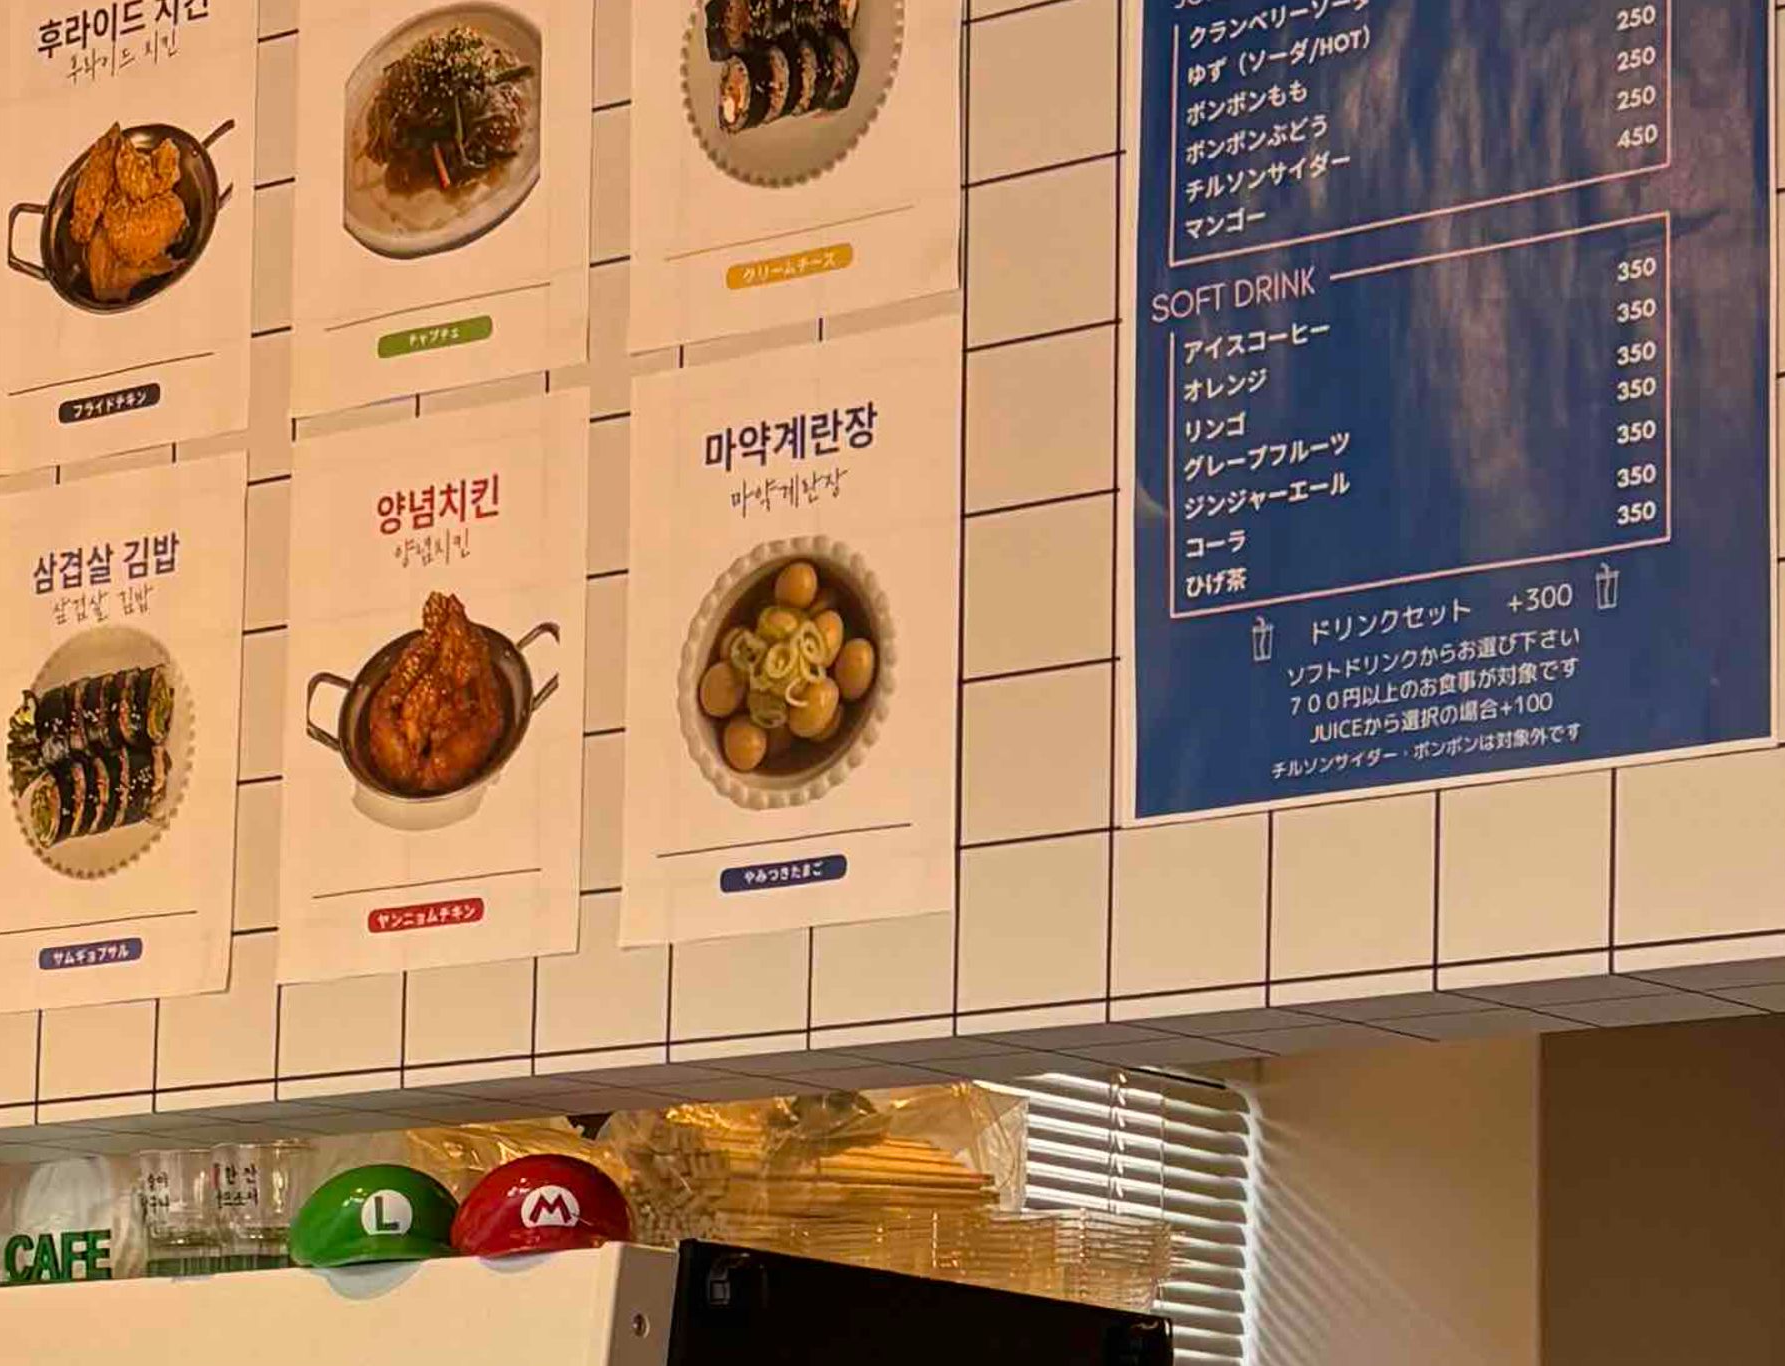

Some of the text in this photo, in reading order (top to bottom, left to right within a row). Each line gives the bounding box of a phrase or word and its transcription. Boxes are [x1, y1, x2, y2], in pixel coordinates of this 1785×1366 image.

[1616, 5, 1656, 31] 250
[1187, 57, 1228, 88] ゆず
[1616, 46, 1656, 72] 250
[1616, 86, 1656, 112] 250
[1616, 124, 1659, 150] 450
[1185, 156, 1352, 204] チルソンサイダー
[1184, 209, 1267, 241] マンゴー
[741, 251, 837, 285] クリームチーズ
[1151, 267, 1316, 325] SOFT DRINK
[1183, 257, 1657, 364] アイスコーヒー 350
[1183, 298, 1657, 404] オレンジ 350
[72, 387, 147, 417] フライドチキン
[1184, 340, 1657, 443] リンゴ 350
[704, 401, 879, 473] 마약계란장
[1183, 378, 1657, 481] グレープフルーツ 350
[729, 466, 848, 519] 마약계란장
[1183, 419, 1657, 519] ジンジャーエール 350
[375, 472, 502, 536] 양념치킨
[1184, 462, 1657, 559] コーラ 350
[32, 532, 181, 595] 삼겹살 김밥
[1185, 501, 1657, 599] ひげ茶 350
[1311, 583, 1574, 647] ドリンクセット +300
[1287, 626, 1581, 688] ソフトドリンクからお選び下さい
[374, 902, 476, 930] ヤンニョムチキン
[374, 1195, 401, 1232] L
[528, 1187, 573, 1224] M
[6, 1230, 112, 1283] CAFE
